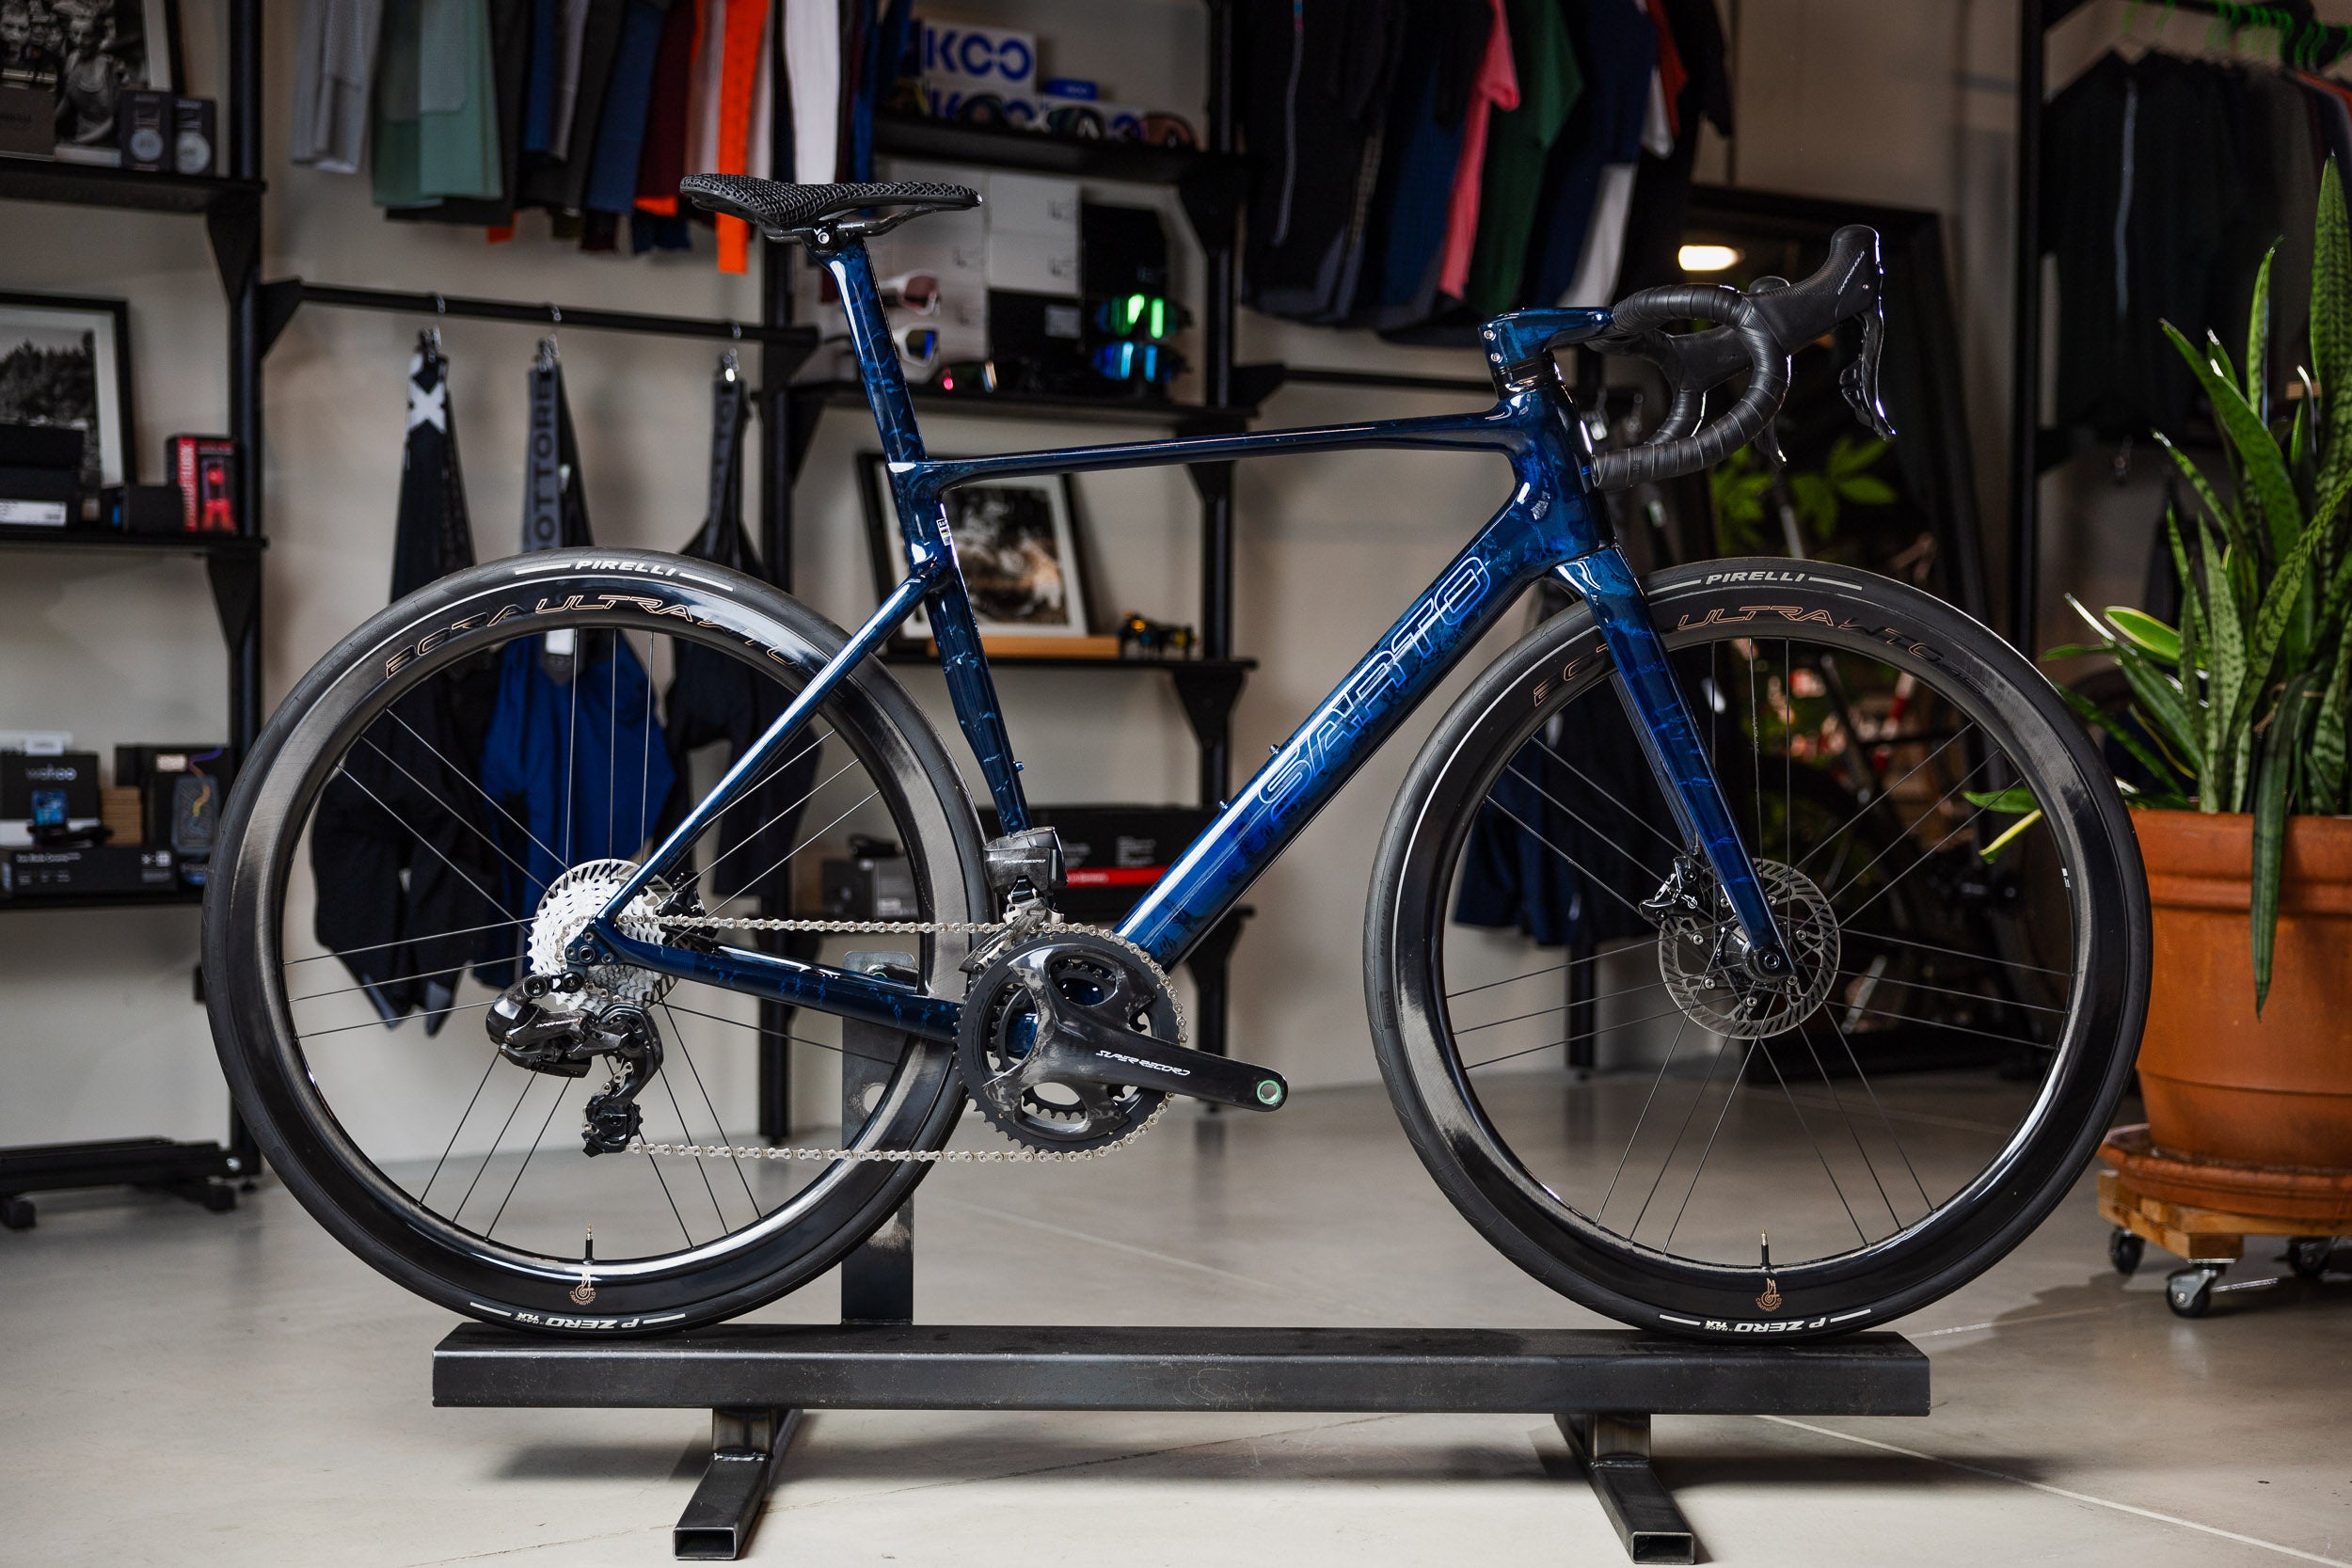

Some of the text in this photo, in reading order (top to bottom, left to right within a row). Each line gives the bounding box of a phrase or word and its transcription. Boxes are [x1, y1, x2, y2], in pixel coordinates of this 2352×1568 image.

[926, 28, 1031, 81] KOO
[1837, 250, 1865, 294] CAMPAGNOLO
[575, 560, 676, 577] PIRELLI
[1706, 571, 1805, 585] PIRELLI
[534, 594, 692, 624] ULTRA
[1677, 605, 1835, 631] ULTRA
[1258, 556, 1492, 822] SARTO
[1095, 1050, 1191, 1076] SUPER RECORD
[1756, 1297, 1783, 1312] CAMPAGNOLO
[544, 1317, 618, 1329] ZERO
[621, 1318, 640, 1328] P
[1734, 1320, 1805, 1332] ZERO
[1808, 1317, 1826, 1329] P
